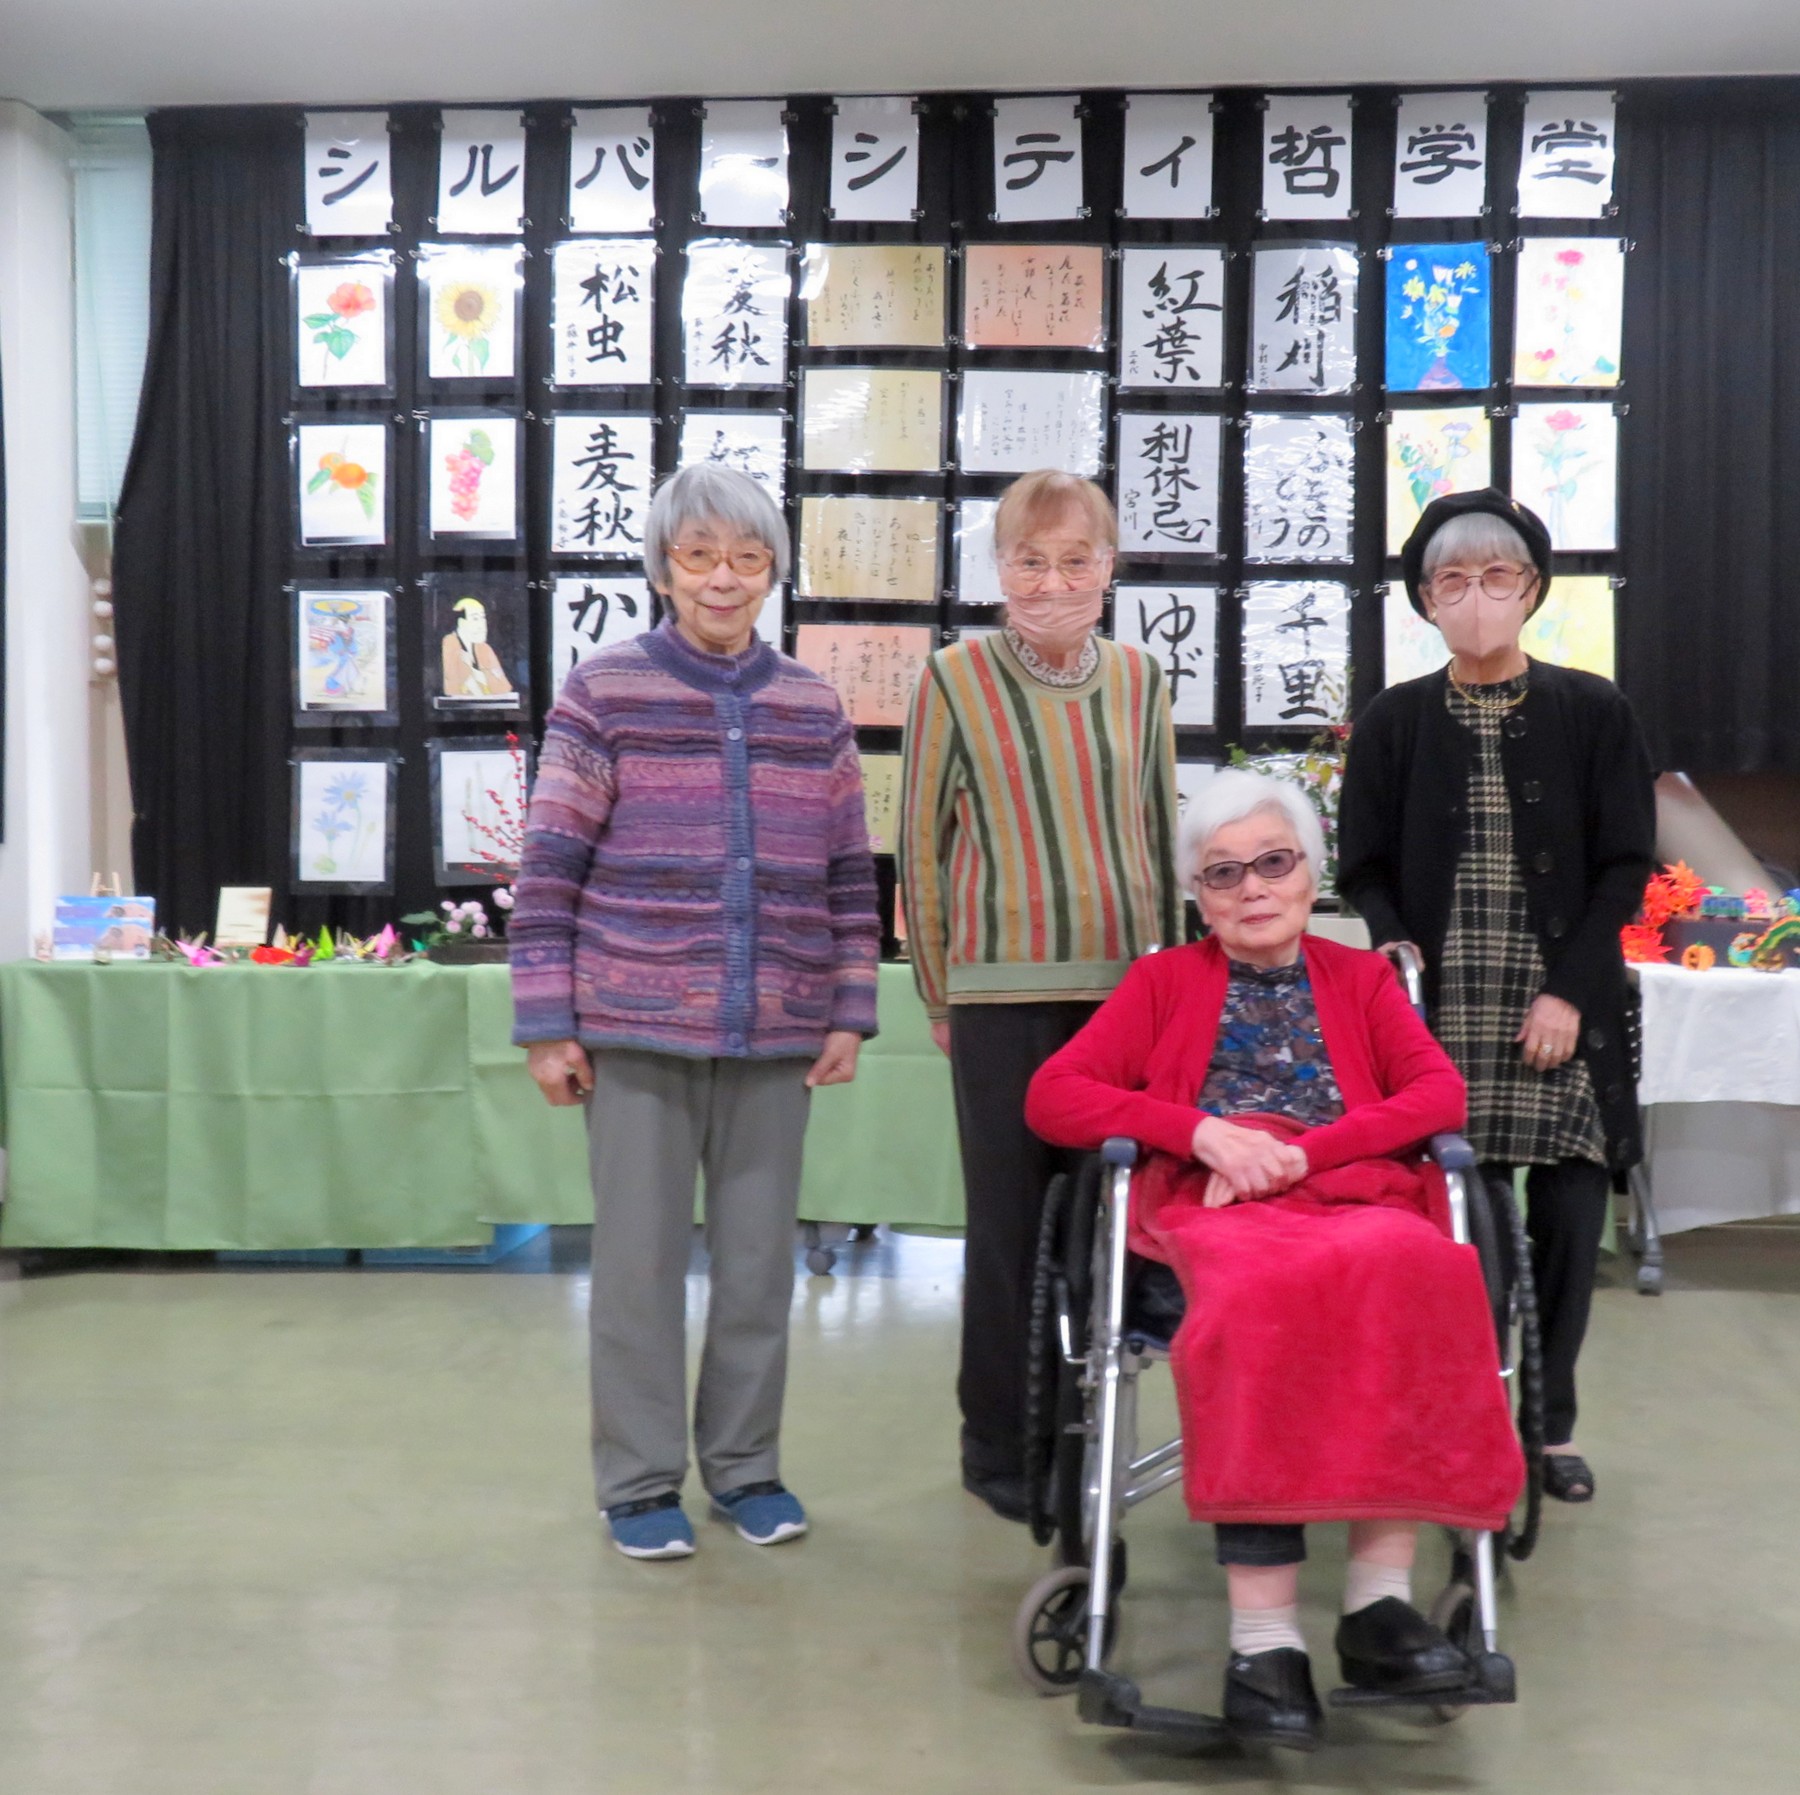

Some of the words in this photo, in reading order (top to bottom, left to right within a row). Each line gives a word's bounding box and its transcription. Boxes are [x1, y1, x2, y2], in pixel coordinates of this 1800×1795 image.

[579, 262, 640, 363] 松虫
[1142, 261, 1223, 383] 紅葉
[1274, 265, 1342, 387] 稲刈
[572, 423, 644, 546] 麦秋
[1140, 421, 1211, 543] 利休忌
